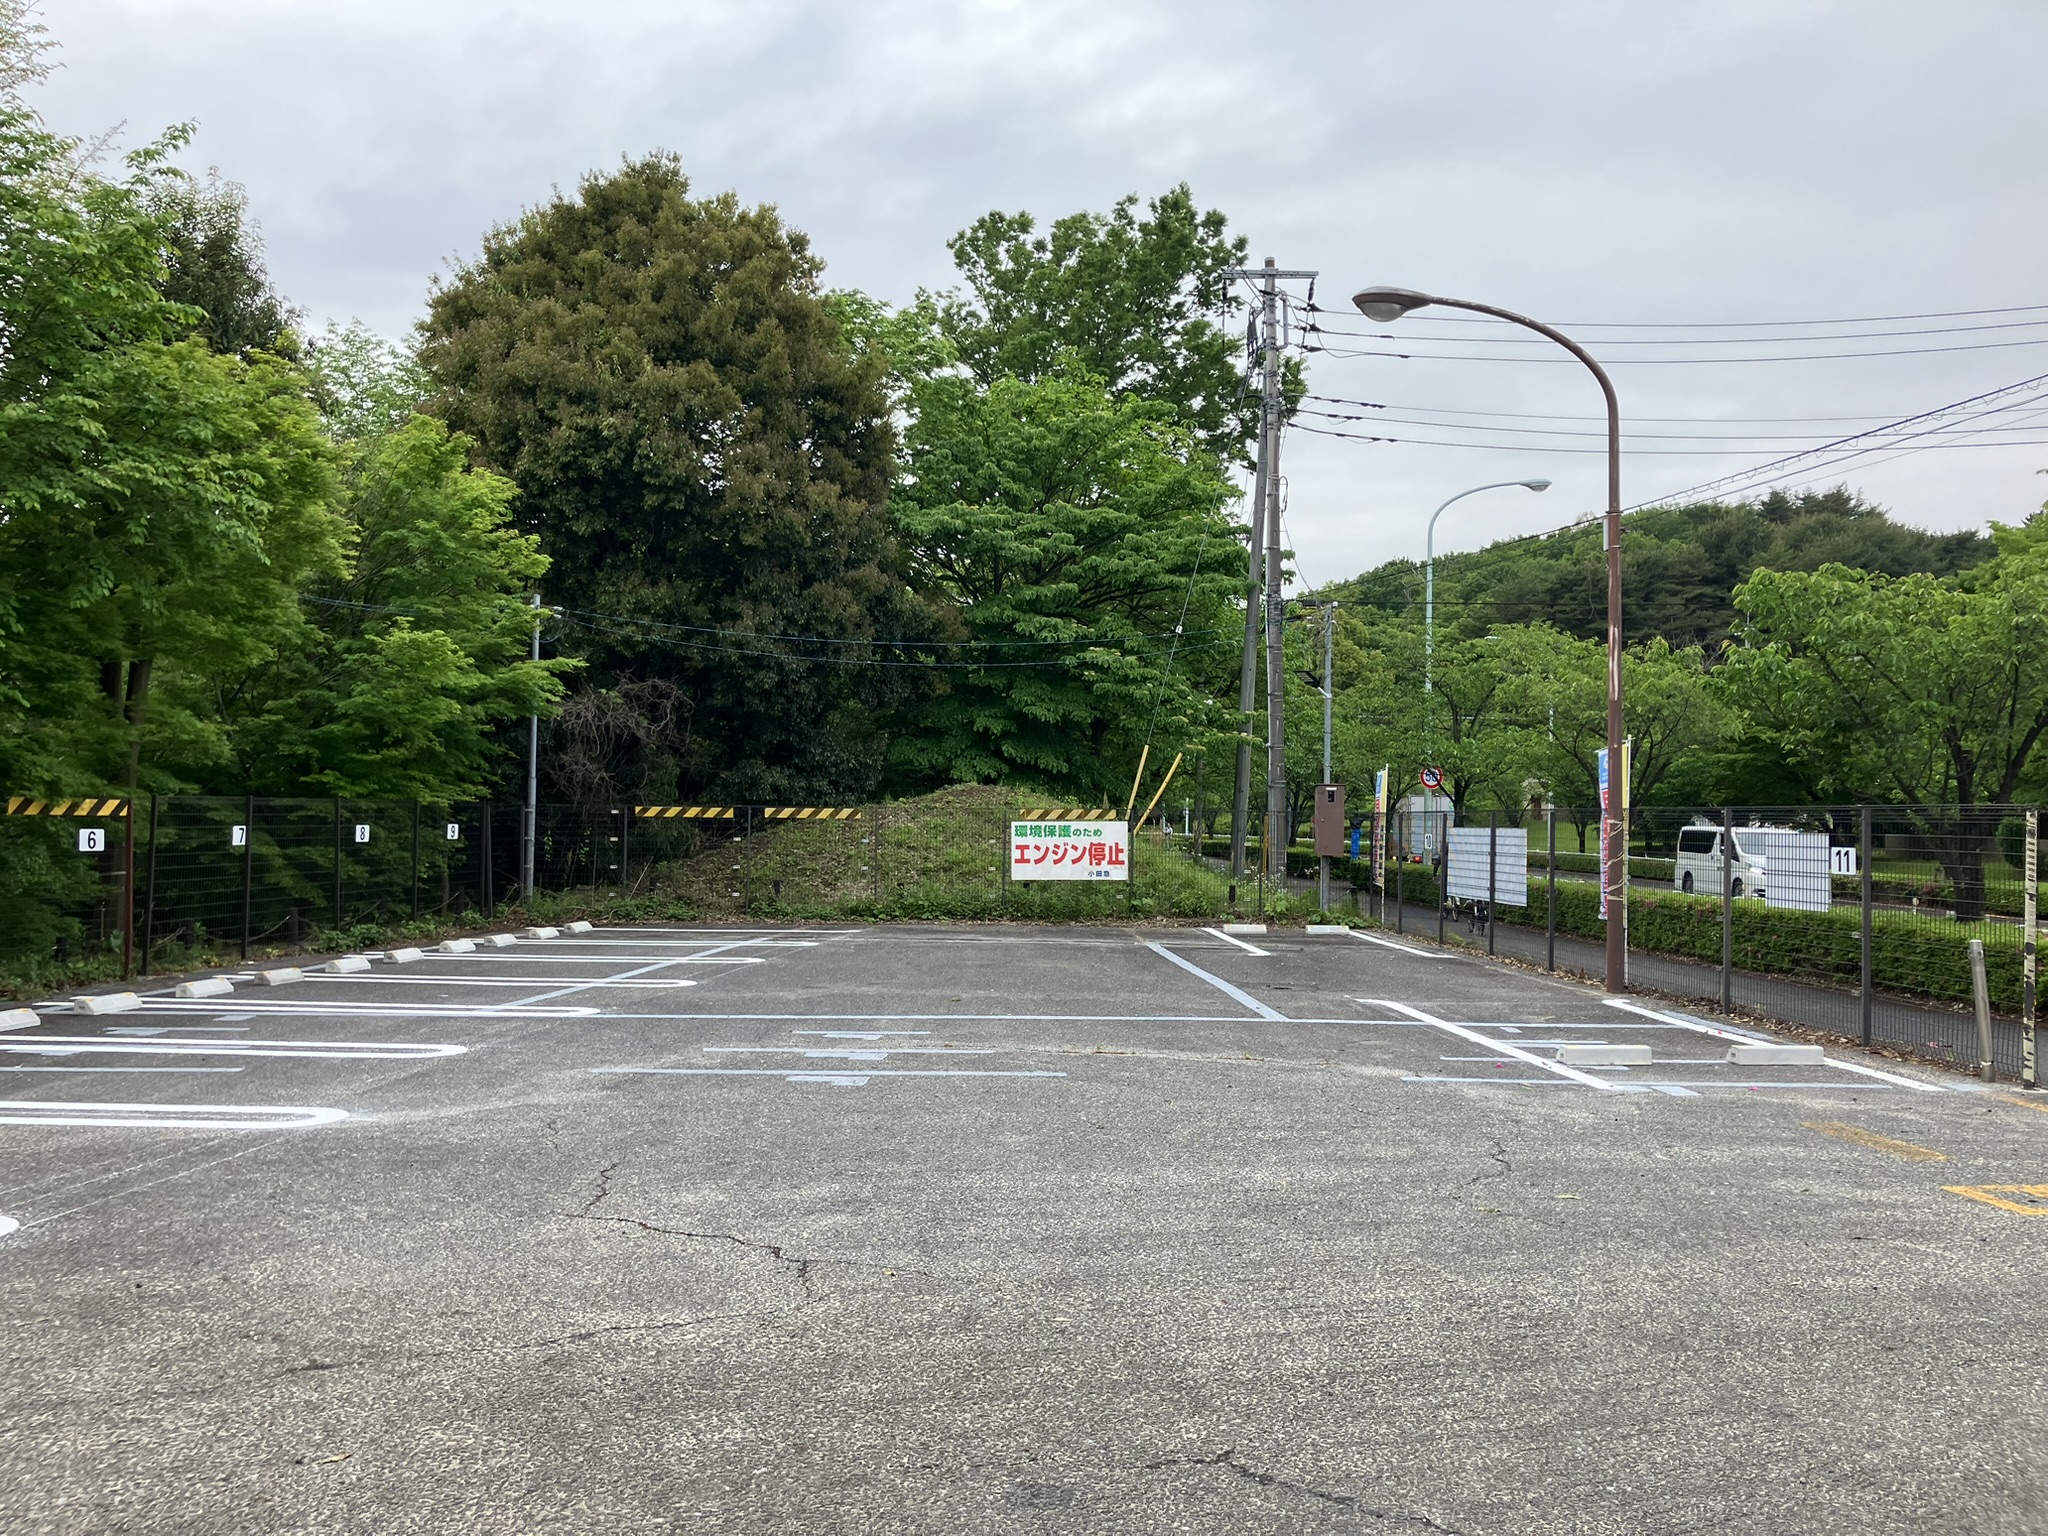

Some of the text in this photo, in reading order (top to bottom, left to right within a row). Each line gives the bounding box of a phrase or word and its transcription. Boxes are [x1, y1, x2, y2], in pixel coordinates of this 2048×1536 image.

[239, 827, 244, 843] 7
[360, 826, 365, 840] 8
[451, 825, 455, 838] 9
[1014, 825, 1102, 838] 環境保護のため
[88, 831, 96, 849] 6
[1014, 842, 1125, 866] エンジン停止
[1835, 849, 1850, 872] 11
